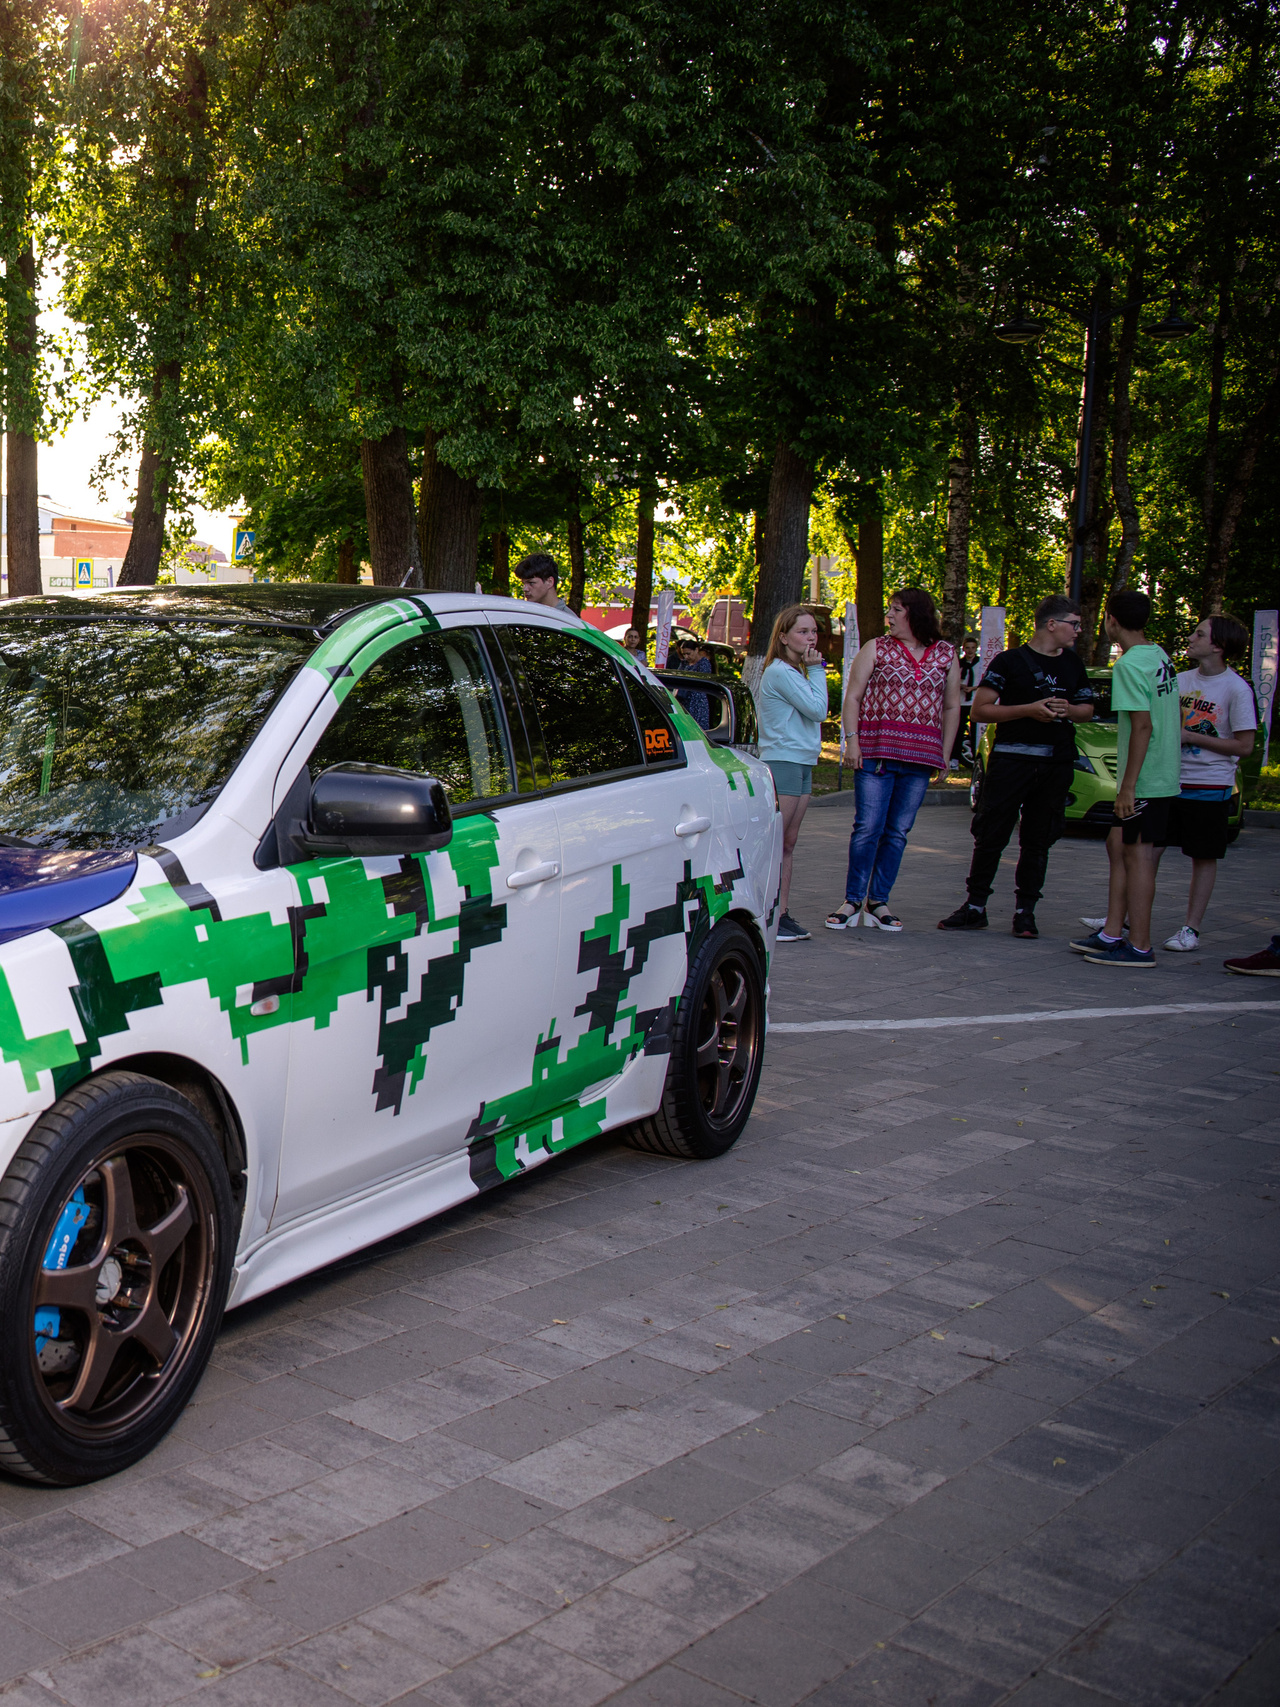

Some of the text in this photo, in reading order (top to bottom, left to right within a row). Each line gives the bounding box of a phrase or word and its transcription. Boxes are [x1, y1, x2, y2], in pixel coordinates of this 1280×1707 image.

[1260, 624, 1273, 659] FEST
[1194, 699, 1216, 713] VIBE
[645, 729, 669, 749] DGR
